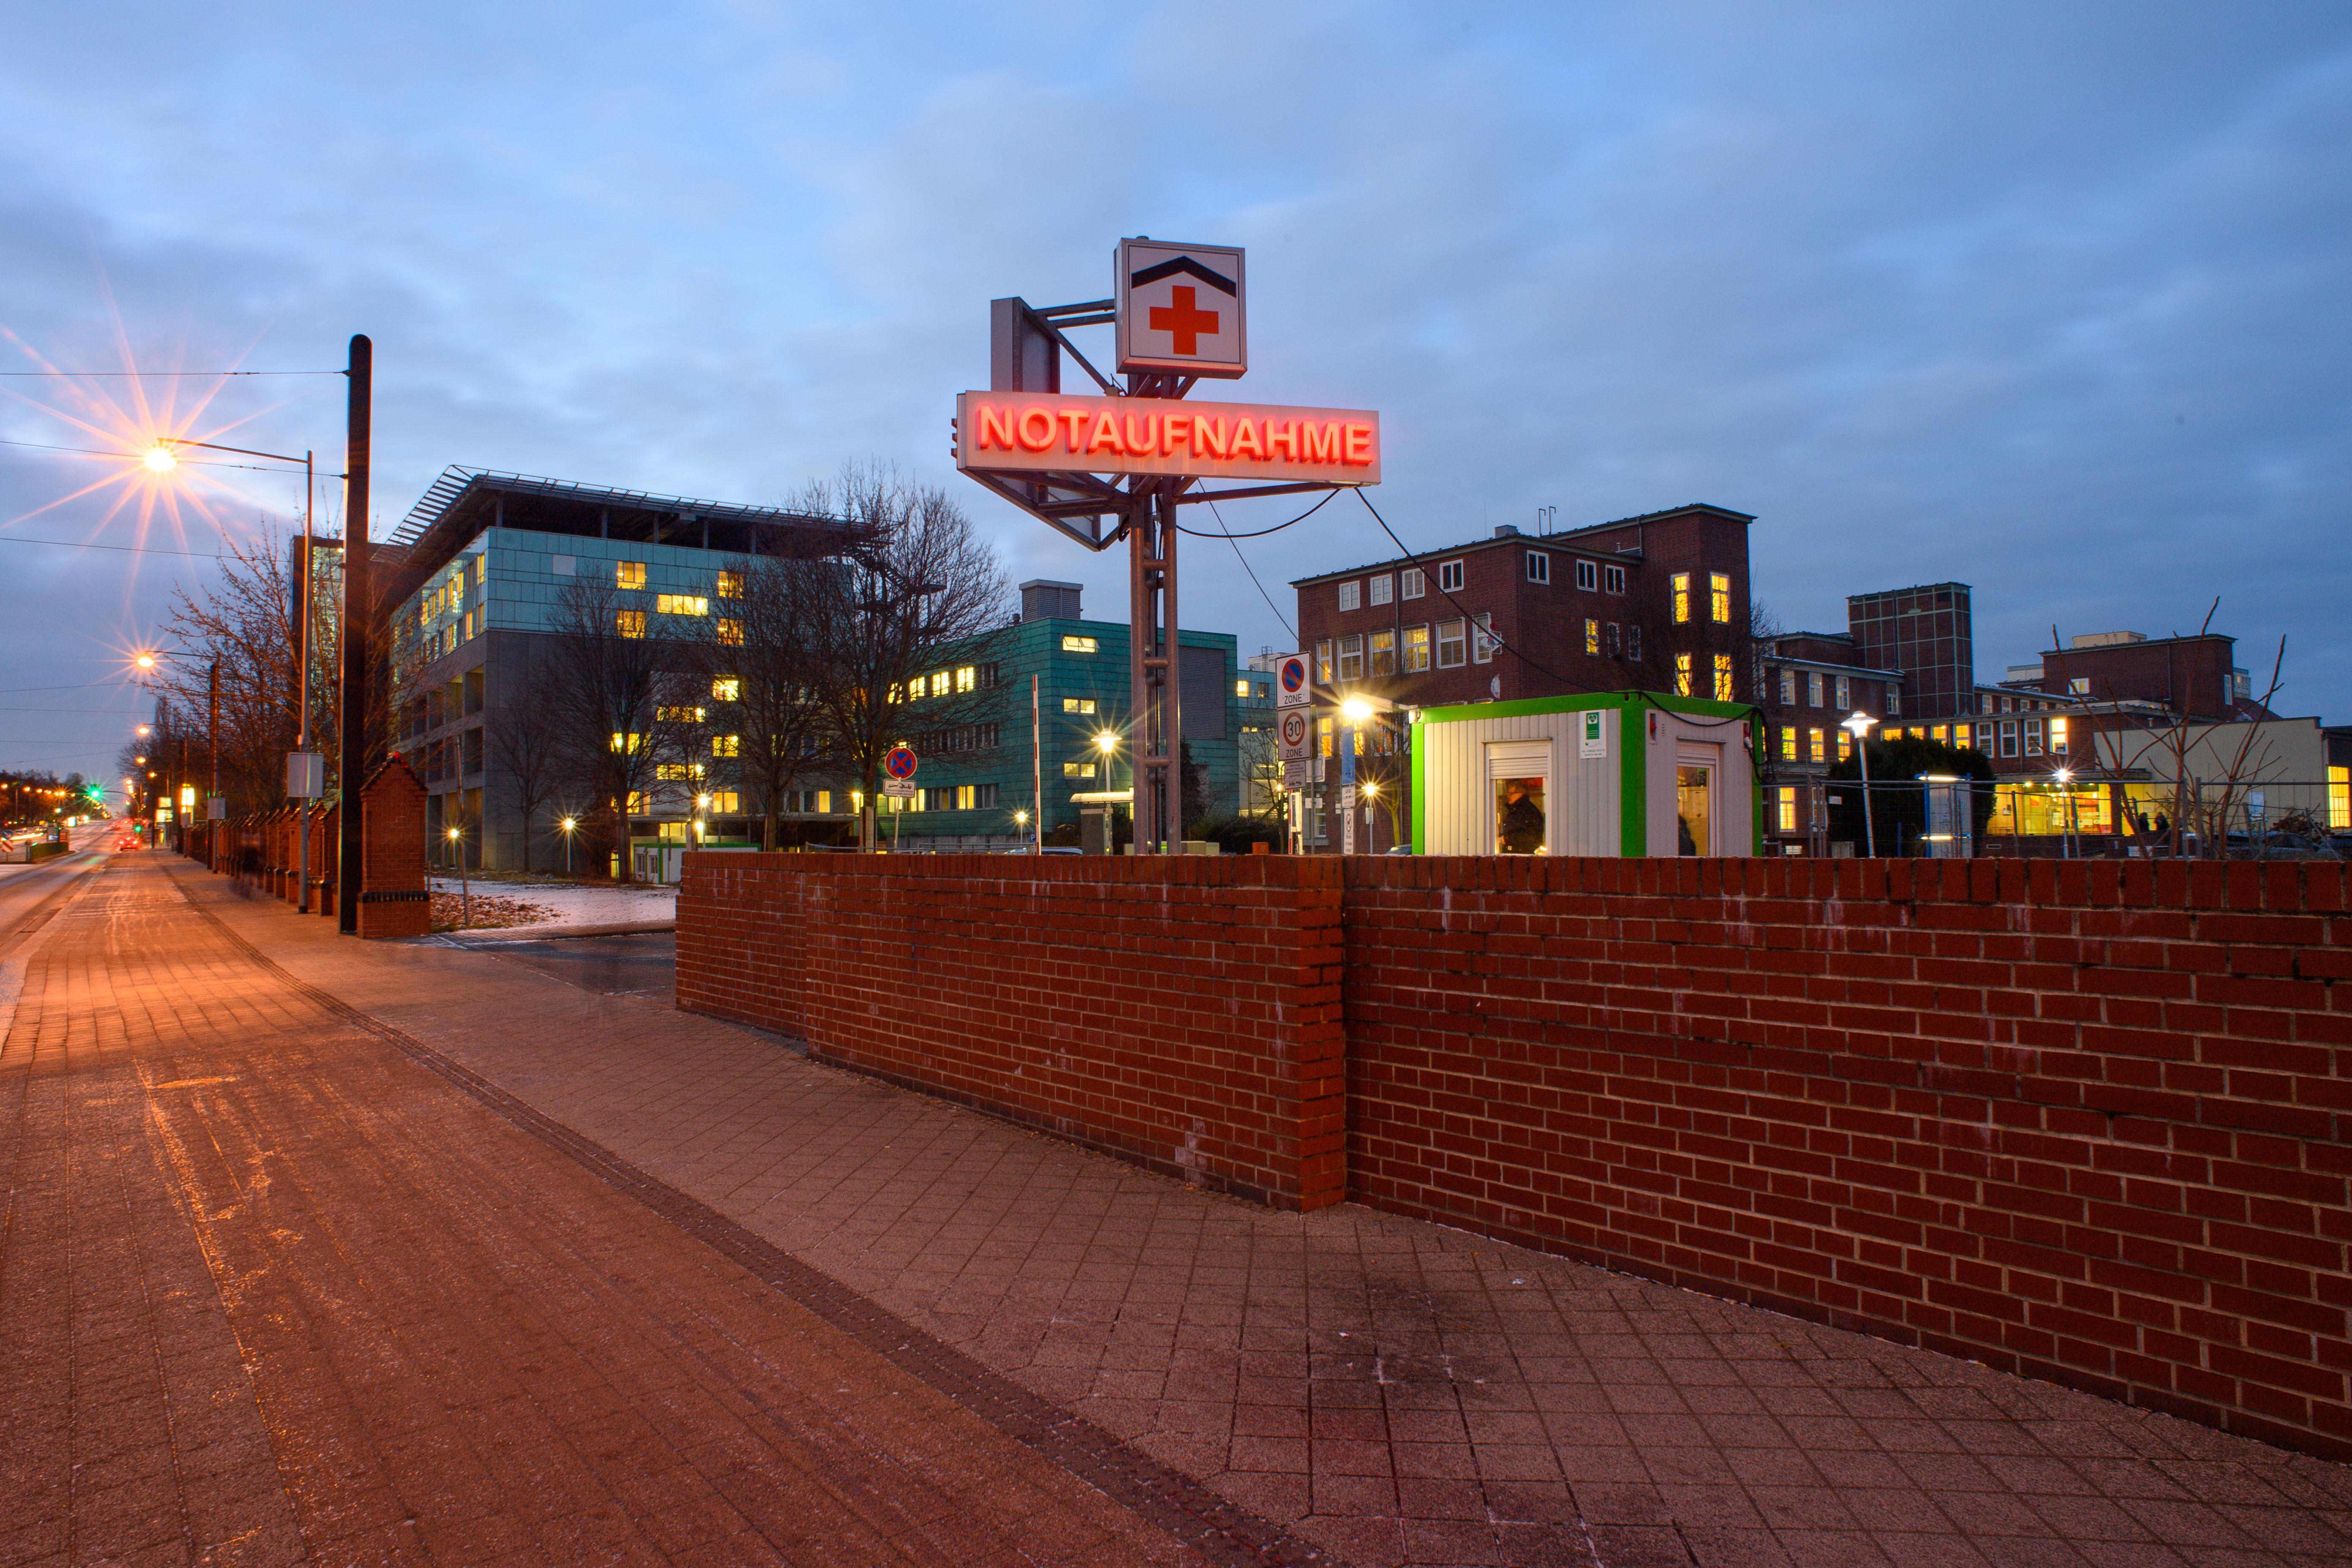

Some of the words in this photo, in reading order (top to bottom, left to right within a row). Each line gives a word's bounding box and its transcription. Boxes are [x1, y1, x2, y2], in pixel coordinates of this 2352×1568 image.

[979, 405, 1374, 466] NOTAUFNAHME
[1284, 694, 1302, 704] ZONE
[1288, 721, 1301, 737] 30
[1286, 748, 1302, 757] ZONE
